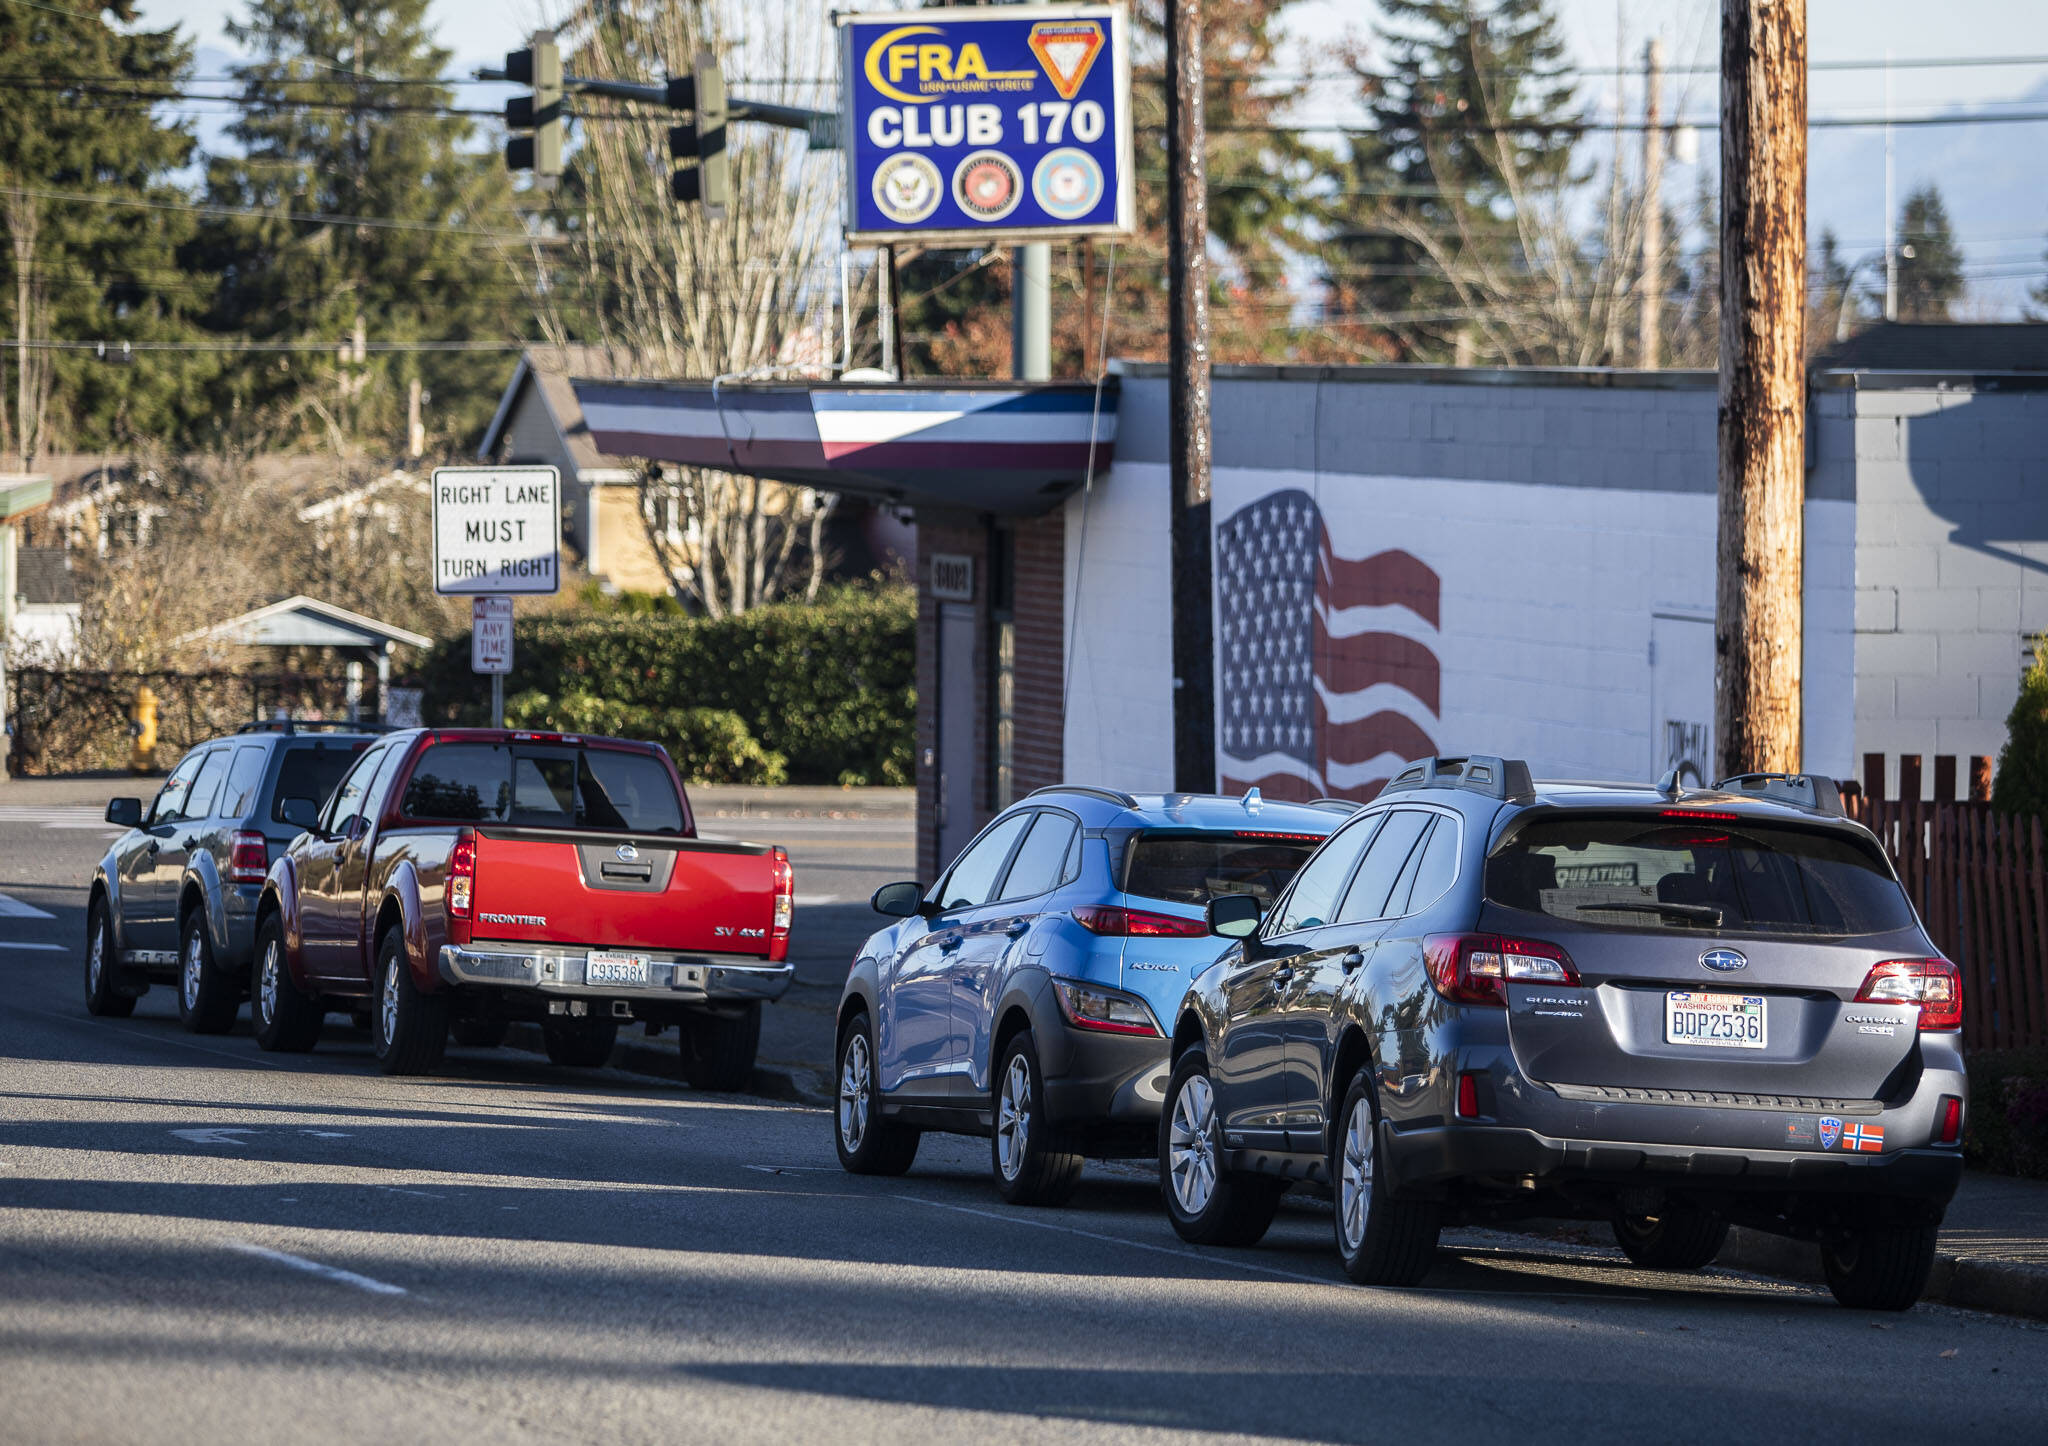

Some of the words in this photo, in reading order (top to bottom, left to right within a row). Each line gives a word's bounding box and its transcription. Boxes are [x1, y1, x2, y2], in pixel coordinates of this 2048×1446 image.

[888, 43, 988, 82] FRA
[867, 103, 1004, 148] CLUB
[1017, 100, 1106, 144] 170
[441, 486, 491, 504] RIGHT
[505, 485, 550, 504] LANE
[466, 520, 526, 543] MUST
[442, 558, 488, 578] TURN
[500, 557, 552, 577] RIGHT
[482, 623, 504, 637] ANY
[480, 638, 506, 655] TIME
[479, 911, 547, 926] FRONTIER
[713, 926, 735, 937] SV
[591, 963, 647, 984] C93538K
[1128, 962, 1180, 972] KONA
[1526, 997, 1589, 1007] SUBARU
[1675, 1001, 1728, 1012] WASHINGTON
[1673, 1011, 1759, 1039] BDP2536
[1845, 1015, 1908, 1026] OUTBACK
